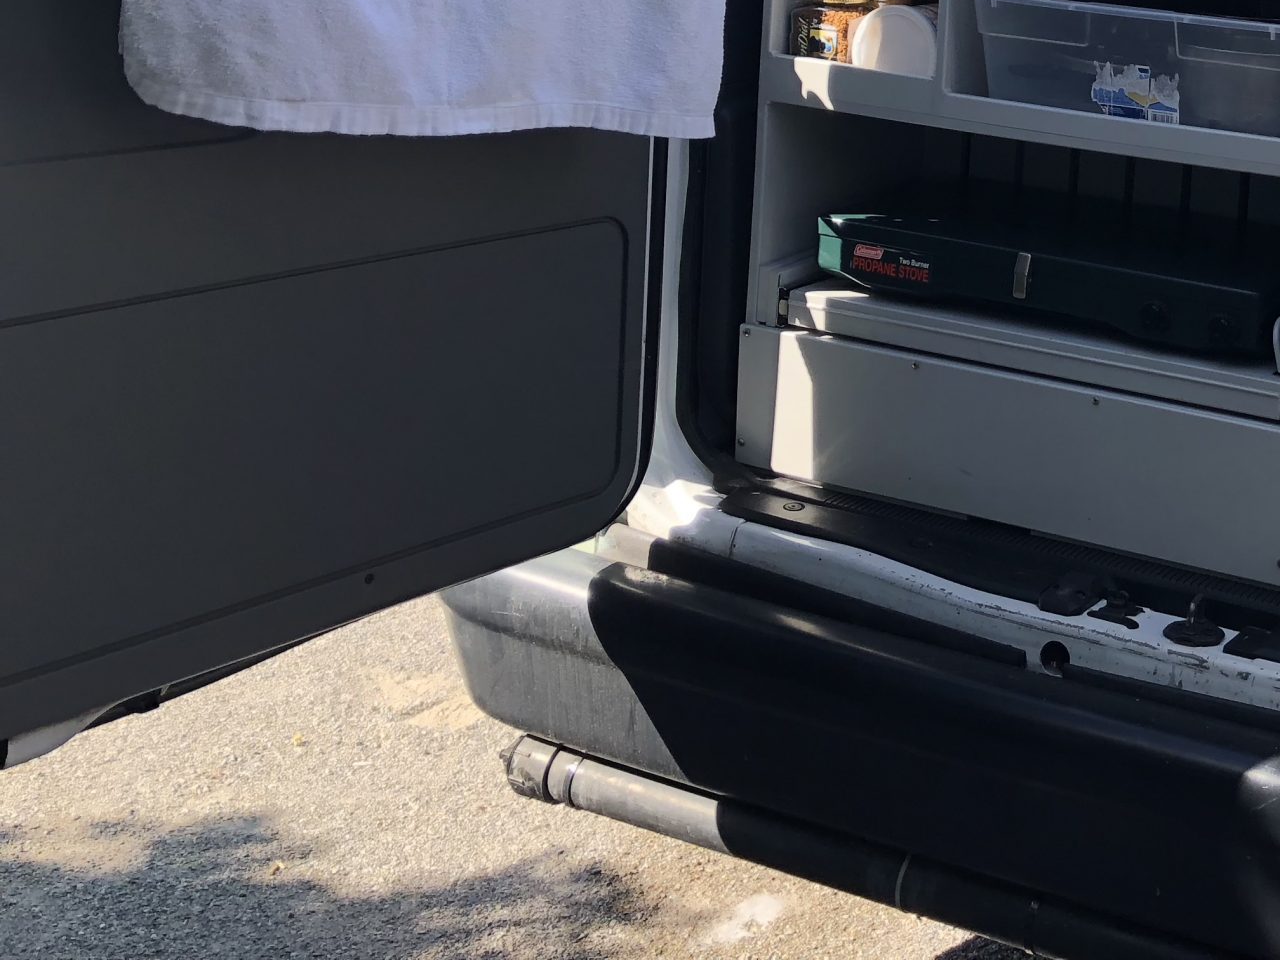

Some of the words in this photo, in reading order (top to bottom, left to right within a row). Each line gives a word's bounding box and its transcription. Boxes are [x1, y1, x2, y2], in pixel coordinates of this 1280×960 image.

[852, 256, 896, 276] PROPANE
[898, 265, 929, 282] STOVE
[899, 257, 910, 265] Two
[911, 259, 930, 268] Burner
